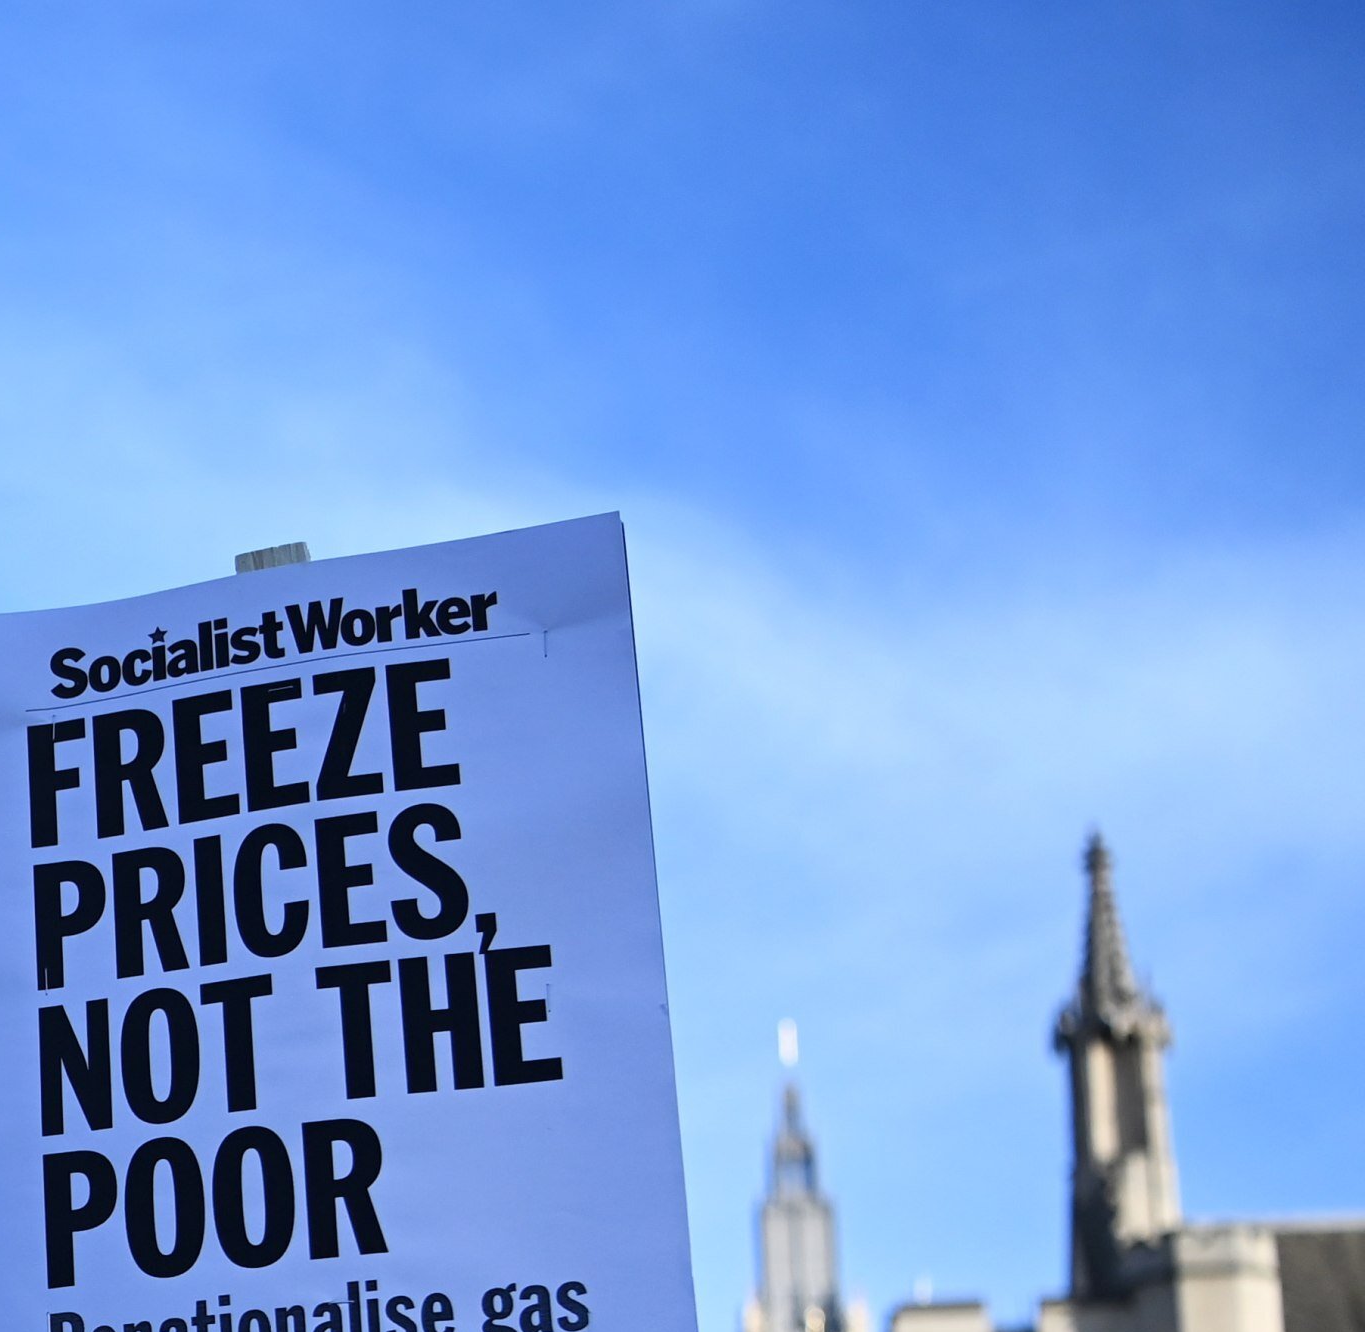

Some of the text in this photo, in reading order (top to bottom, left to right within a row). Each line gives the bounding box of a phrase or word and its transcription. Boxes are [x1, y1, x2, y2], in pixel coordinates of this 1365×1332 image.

[26, 657, 461, 849] FREEZE
[32, 802, 498, 991] PRICES,
[37, 943, 564, 1137] NOT THE
[42, 1118, 389, 1290] POOR
